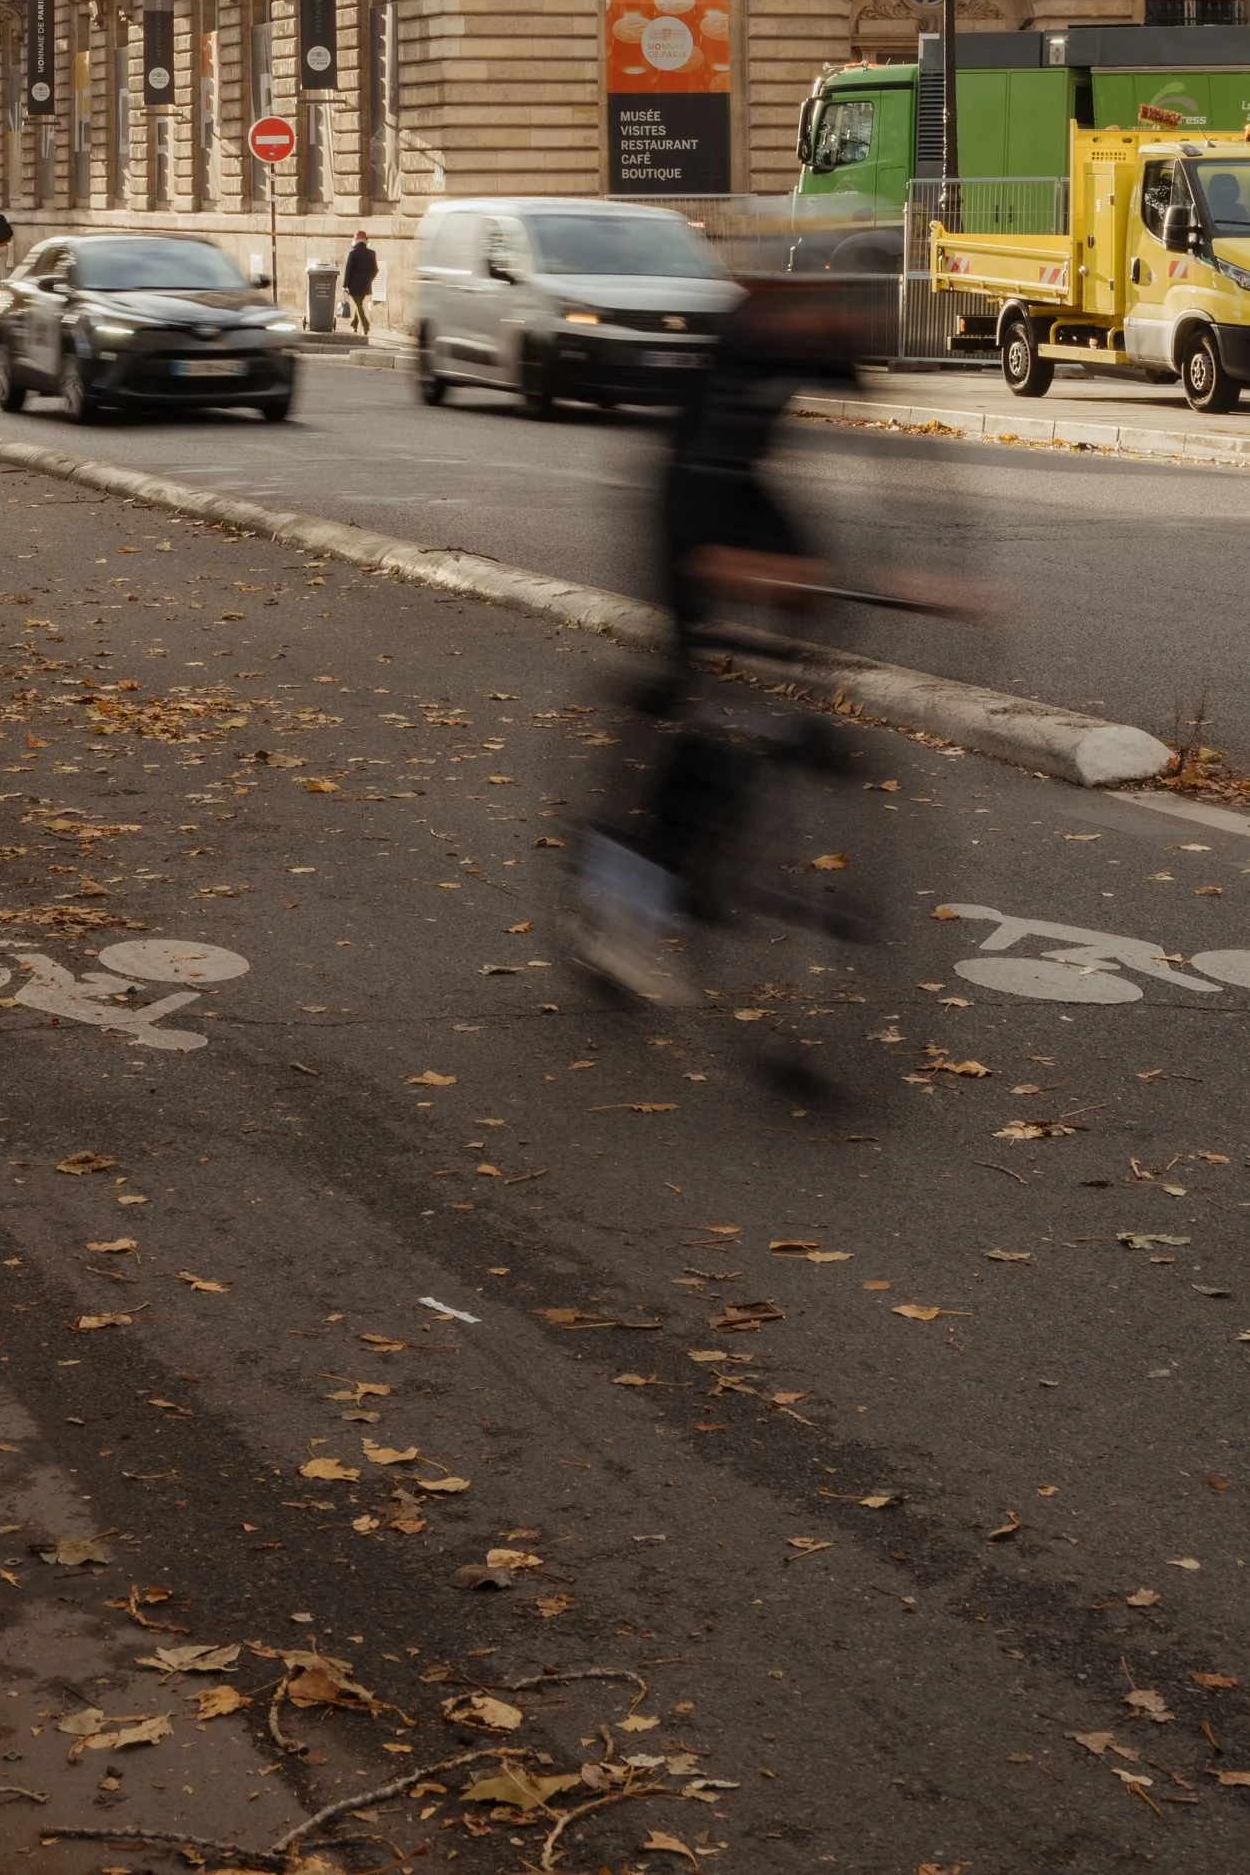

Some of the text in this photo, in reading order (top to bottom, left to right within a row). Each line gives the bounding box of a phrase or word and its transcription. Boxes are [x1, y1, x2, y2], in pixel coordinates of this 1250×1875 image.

[37, 22, 44, 34] DE
[620, 110, 661, 122] MUSÉE
[620, 125, 666, 136] VISITES
[621, 139, 698, 150] RESTAURANT
[621, 152, 651, 165] CAFÉ
[621, 168, 682, 181] BOUTIQUE
